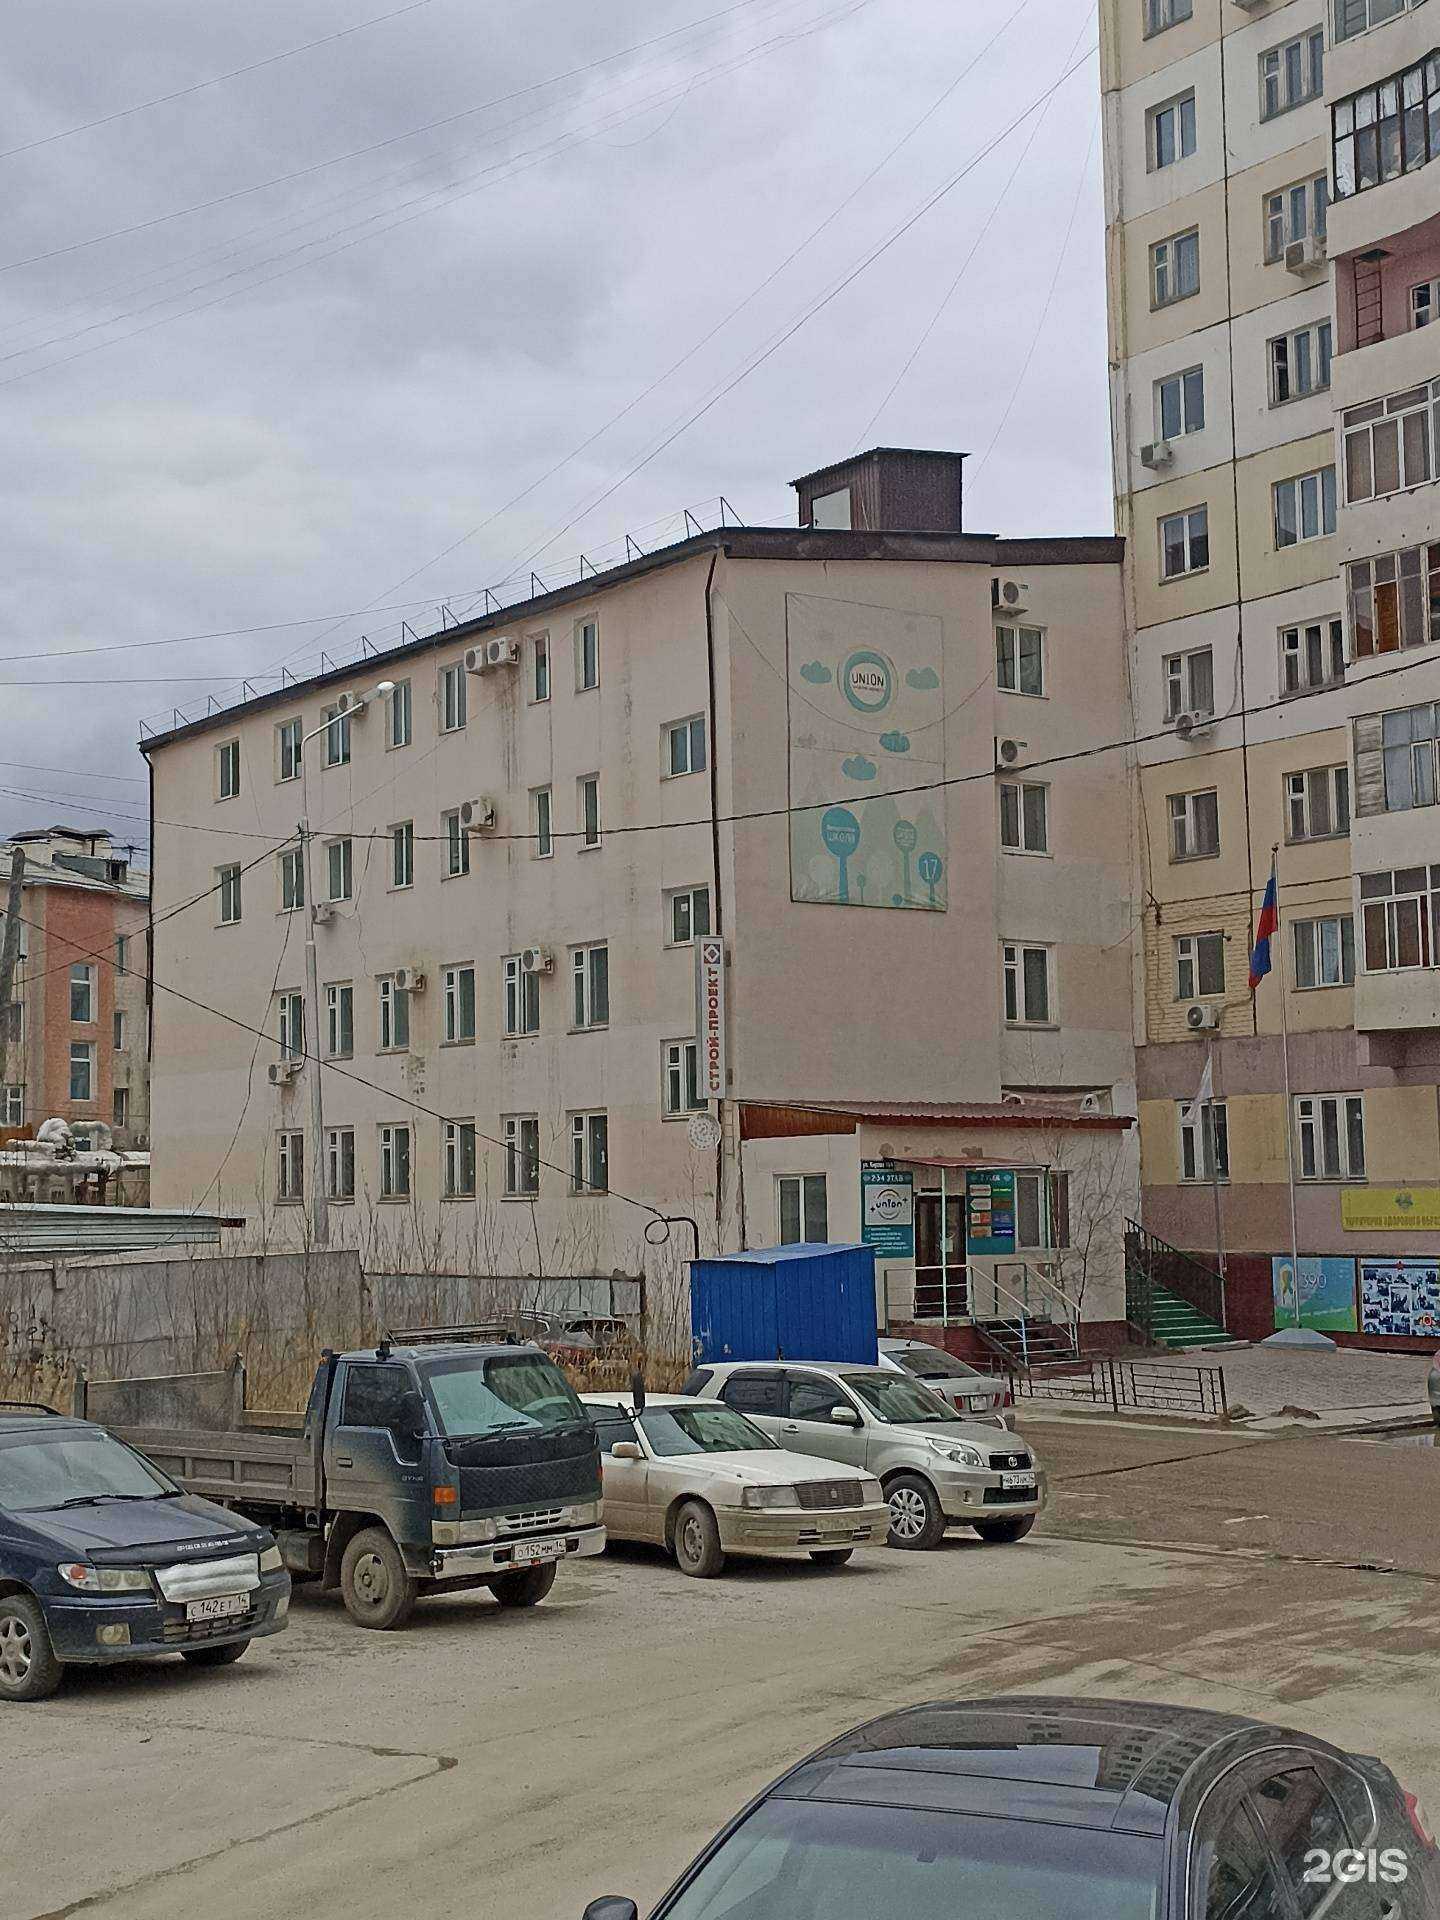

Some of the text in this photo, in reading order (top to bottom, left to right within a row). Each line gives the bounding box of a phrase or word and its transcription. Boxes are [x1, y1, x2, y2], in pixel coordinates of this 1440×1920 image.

[851, 672, 884, 687] UNION
[922, 858, 938, 880] 17
[707, 967, 721, 1092] СТРОЙ-ПРОЕКТ
[875, 1198, 903, 1208] union
